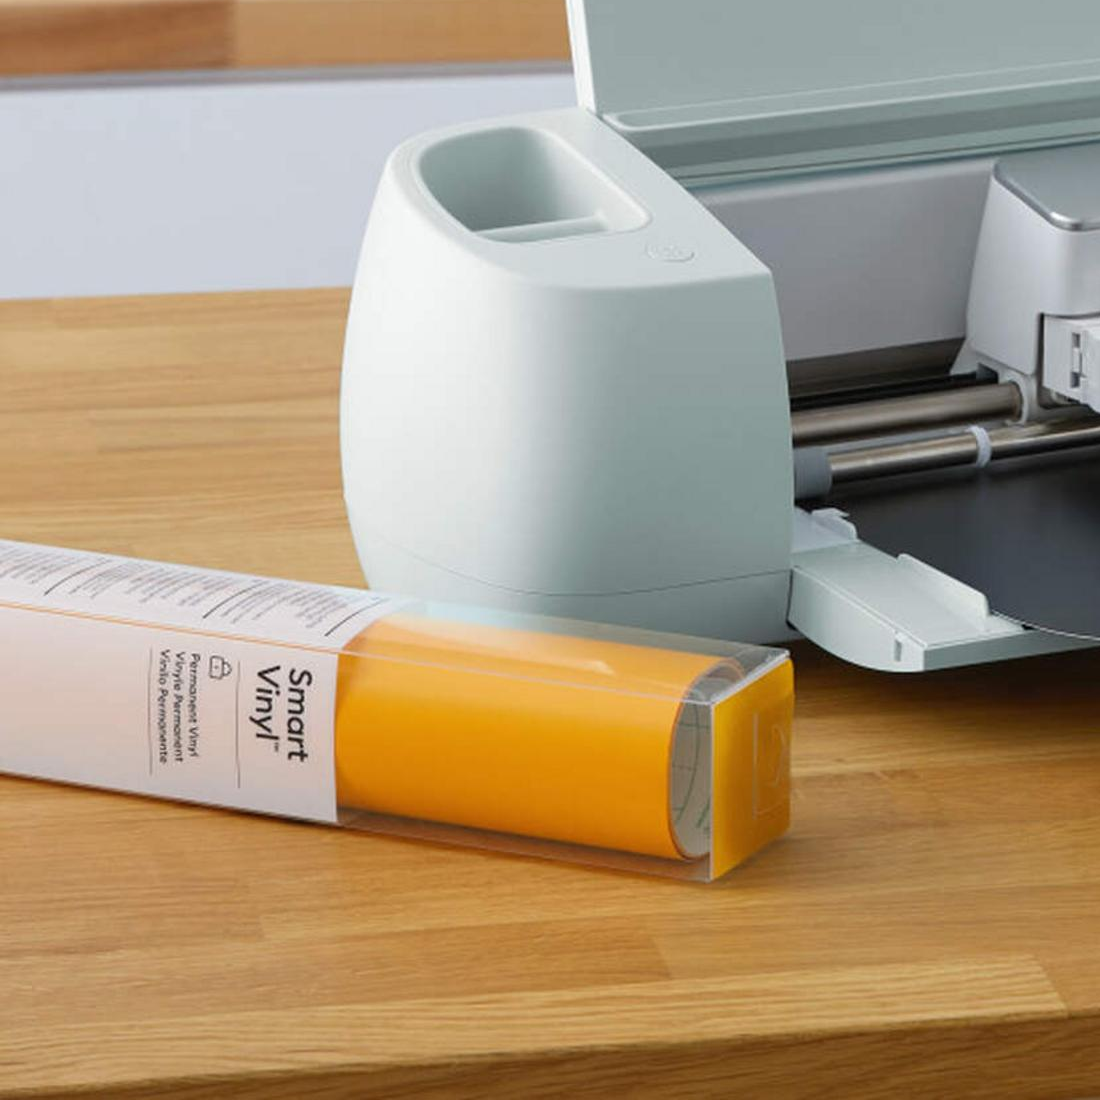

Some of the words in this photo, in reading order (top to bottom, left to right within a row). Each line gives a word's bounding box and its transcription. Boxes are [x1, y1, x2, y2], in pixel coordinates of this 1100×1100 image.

[159, 649, 171, 686] Vinilo
[173, 651, 186, 692] Vinyle
[188, 653, 200, 722] Permanent
[158, 688, 170, 764] Permanente
[173, 692, 185, 763] Permanent
[187, 724, 199, 757] Vinyl
[286, 667, 312, 762] Smart
